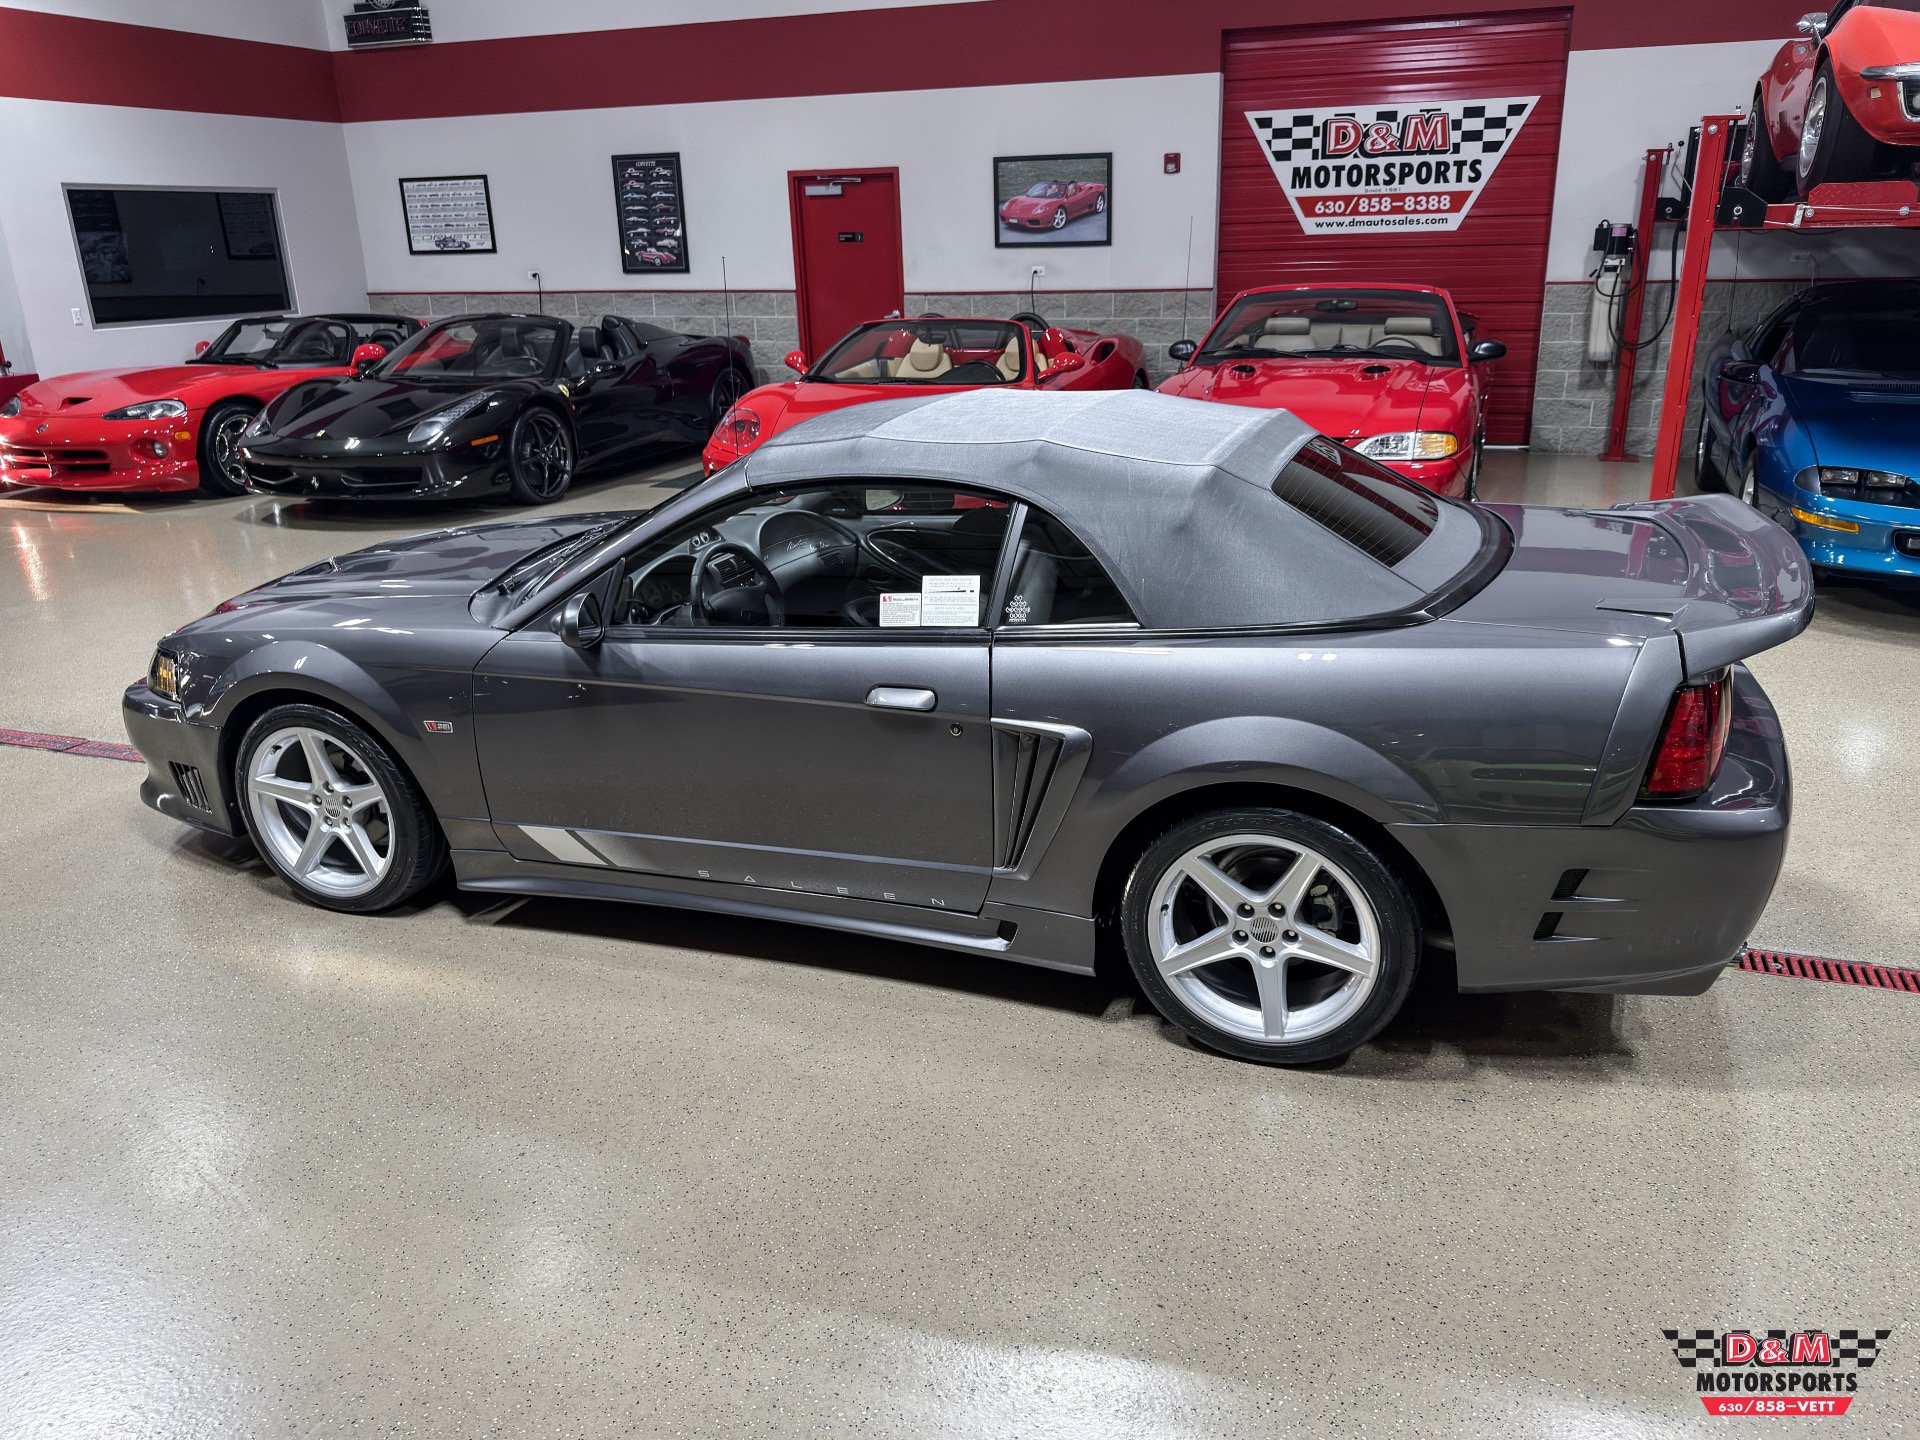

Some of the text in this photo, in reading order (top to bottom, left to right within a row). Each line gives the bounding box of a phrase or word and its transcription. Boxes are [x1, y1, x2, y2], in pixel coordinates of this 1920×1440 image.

[1323, 112, 1450, 157] D&M
[1291, 159, 1482, 189] MOTORSPORTS
[1314, 195, 1451, 214] 630/858-8388
[1315, 216, 1449, 228] www.dmautosales.com
[698, 869, 945, 906] SALEEN
